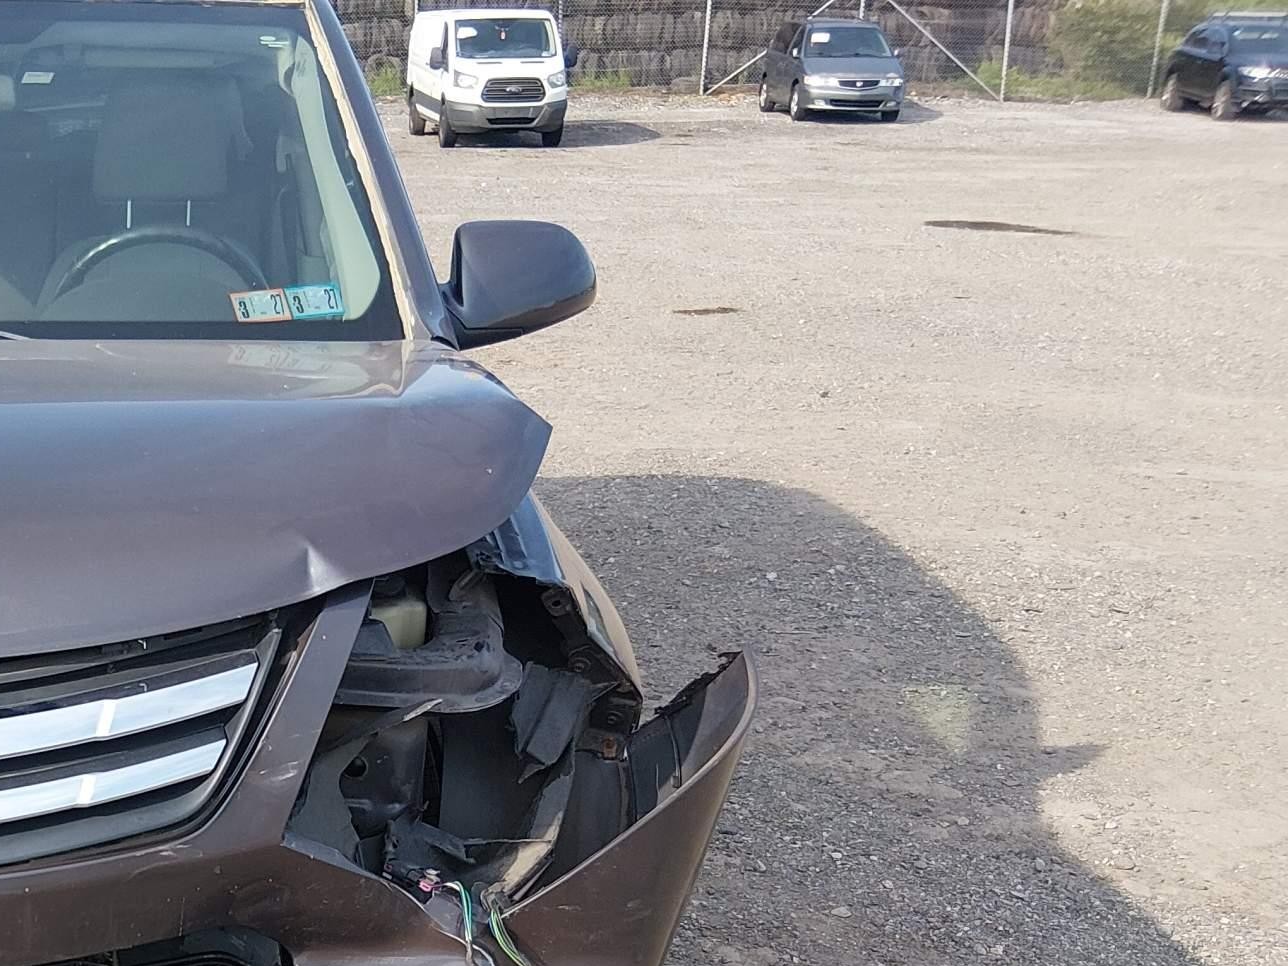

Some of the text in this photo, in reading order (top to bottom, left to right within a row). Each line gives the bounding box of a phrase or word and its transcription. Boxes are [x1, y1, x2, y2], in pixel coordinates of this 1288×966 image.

[238, 293, 285, 319] 3 27
[293, 288, 339, 315] 3 27
